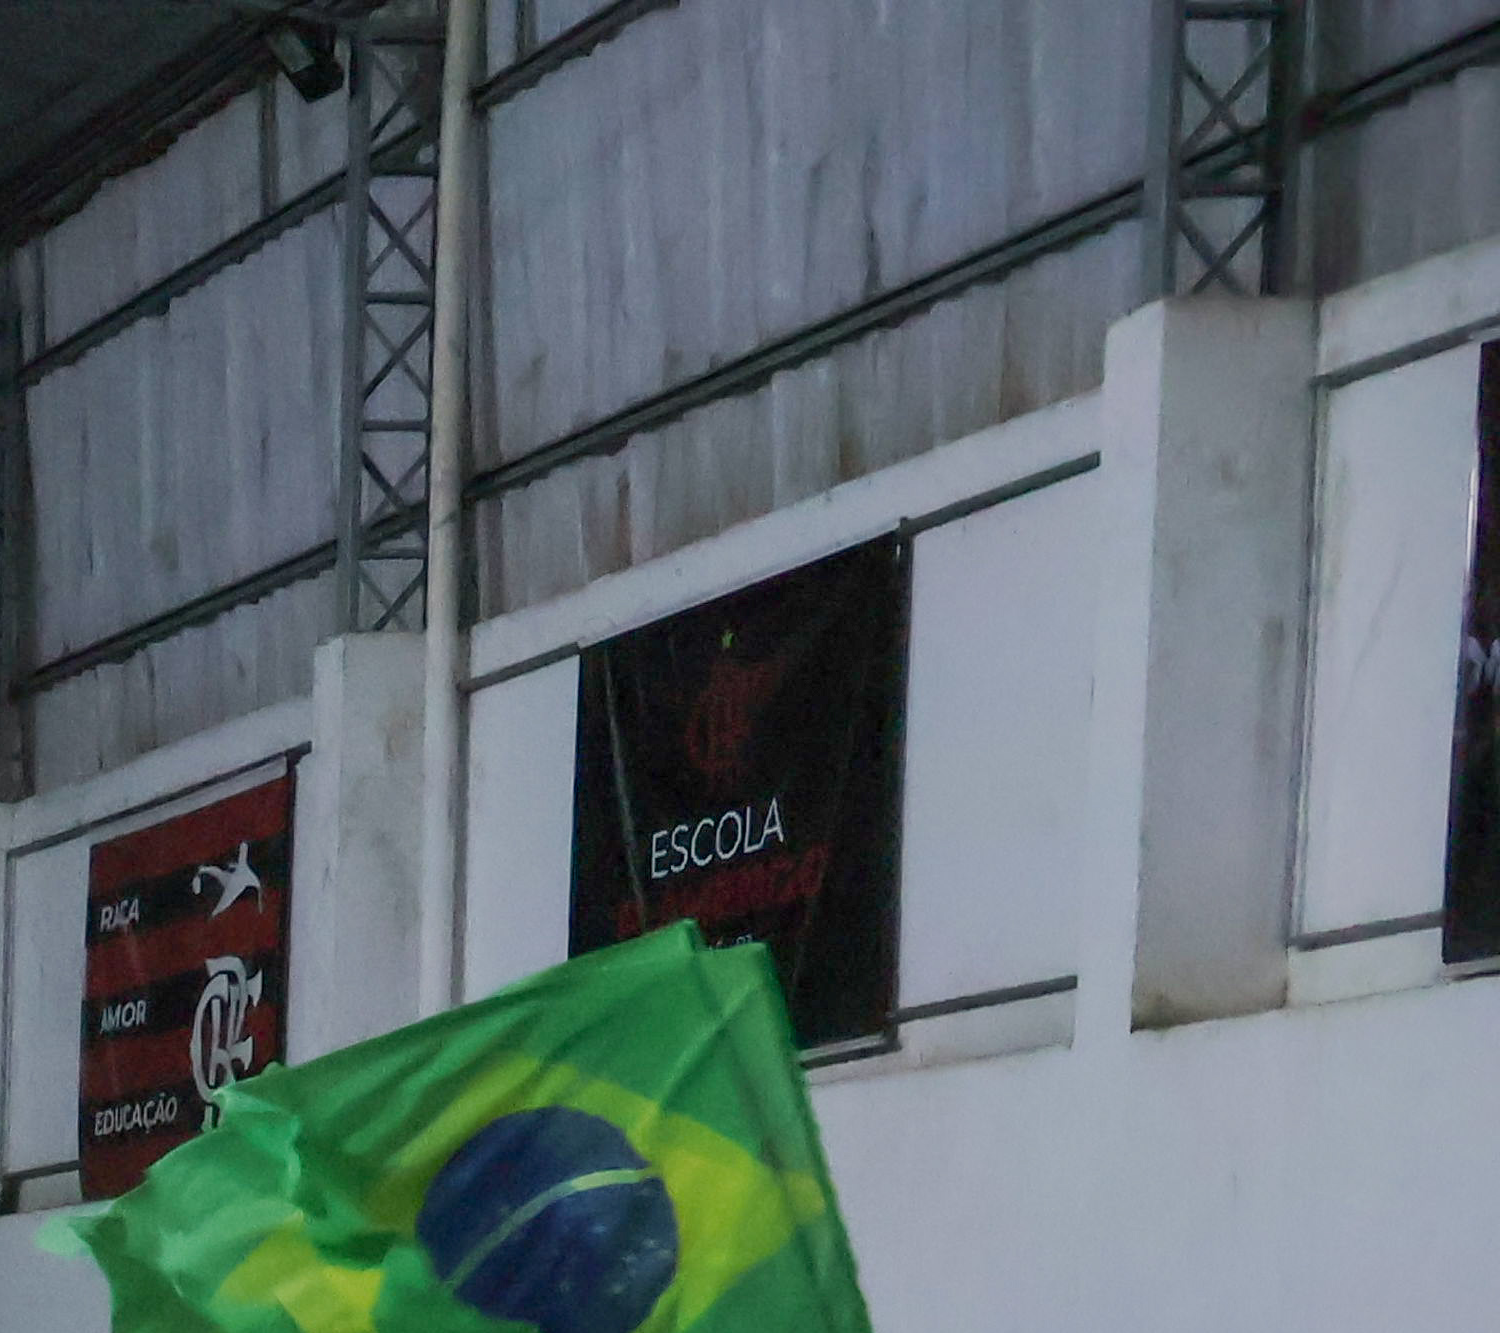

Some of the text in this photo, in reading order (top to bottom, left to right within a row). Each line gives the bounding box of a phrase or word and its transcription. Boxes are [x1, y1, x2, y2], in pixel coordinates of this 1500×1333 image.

[651, 797, 784, 880] ESCOLA
[100, 1000, 147, 1034] AMOR
[94, 1092, 178, 1136] EDUCAÇÃO
